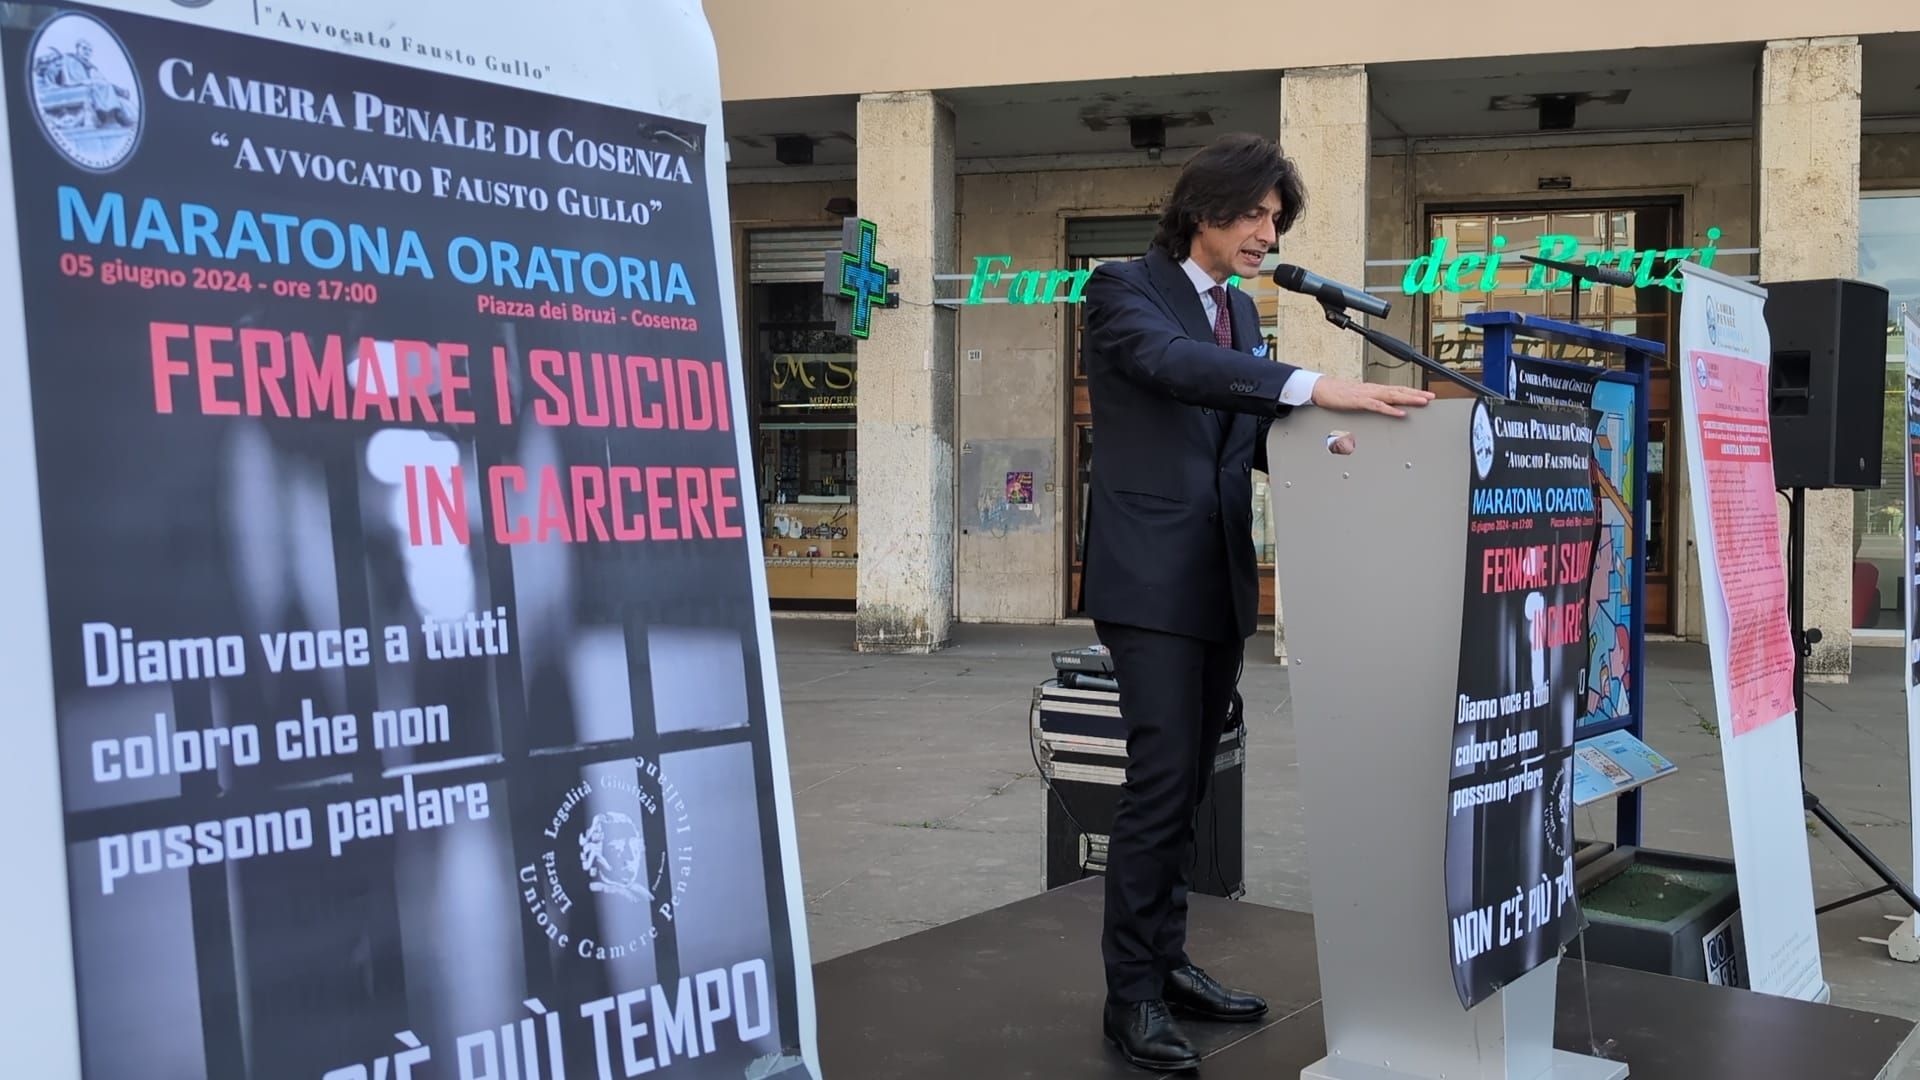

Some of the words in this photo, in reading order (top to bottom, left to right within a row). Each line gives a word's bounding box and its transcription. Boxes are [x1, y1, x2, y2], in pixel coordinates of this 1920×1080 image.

[265, 6, 391, 49] "Avvocato
[401, 36, 476, 66] Fausto
[485, 55, 552, 80] Gullo"
[158, 57, 345, 127] CAMERA
[352, 90, 496, 152] PENALE
[504, 125, 540, 159] DI
[548, 127, 693, 184] COSENZA
[431, 167, 549, 210] FAUSTO
[558, 187, 662, 225] GULLO”
[57, 185, 434, 280] MARATONA
[448, 236, 696, 305] ORATORIA
[1401, 235, 1509, 296] dei
[60, 253, 94, 278] 05
[101, 259, 186, 289] giugno
[192, 267, 251, 293] 2024
[273, 279, 312, 299] ore
[317, 280, 377, 304] 17:00
[477, 294, 534, 318] Piazza
[540, 298, 567, 321] dei
[572, 304, 616, 325] Bruzi
[631, 309, 697, 331] Cosenza
[150, 322, 476, 424] FERMARE
[492, 346, 512, 425] I
[529, 348, 730, 432] SUICIDI
[773, 354, 817, 390] M.
[1494, 416, 1529, 440] CAMERA
[1530, 419, 1561, 441] PENALE
[1544, 452, 1572, 470] FAUSTO
[403, 465, 470, 546] IN
[488, 465, 743, 545] CARCERE
[1472, 487, 1543, 515] MARATONA
[1482, 544, 1549, 594] FERMARE
[1551, 544, 1556, 586] I
[81, 622, 246, 687] Diamo
[260, 627, 370, 673] voce
[383, 625, 410, 664] a
[422, 606, 509, 660] tutti
[1458, 693, 1497, 724] Diamo
[1500, 692, 1521, 716] voce
[1523, 690, 1530, 711] a
[91, 712, 260, 783] coloro
[275, 698, 359, 761] che
[372, 704, 450, 749] non
[1455, 734, 1498, 767] coloro
[1500, 727, 1517, 758] che
[1519, 729, 1538, 752] non
[544, 780, 593, 839] Legalità
[600, 775, 657, 815] Giustizia
[634, 756, 691, 834] Italiane
[1453, 779, 1507, 816] possono
[1508, 762, 1543, 803] parlare
[97, 807, 313, 895] possono
[326, 773, 490, 857] parlare
[519, 863, 569, 948] Unione
[658, 846, 693, 921] Penali
[577, 925, 658, 960] Camere
[1453, 905, 1493, 965] NON
[1499, 885, 1524, 947] C'È
[1528, 873, 1552, 933] PIÙ
[580, 957, 772, 1080] TEMPO
